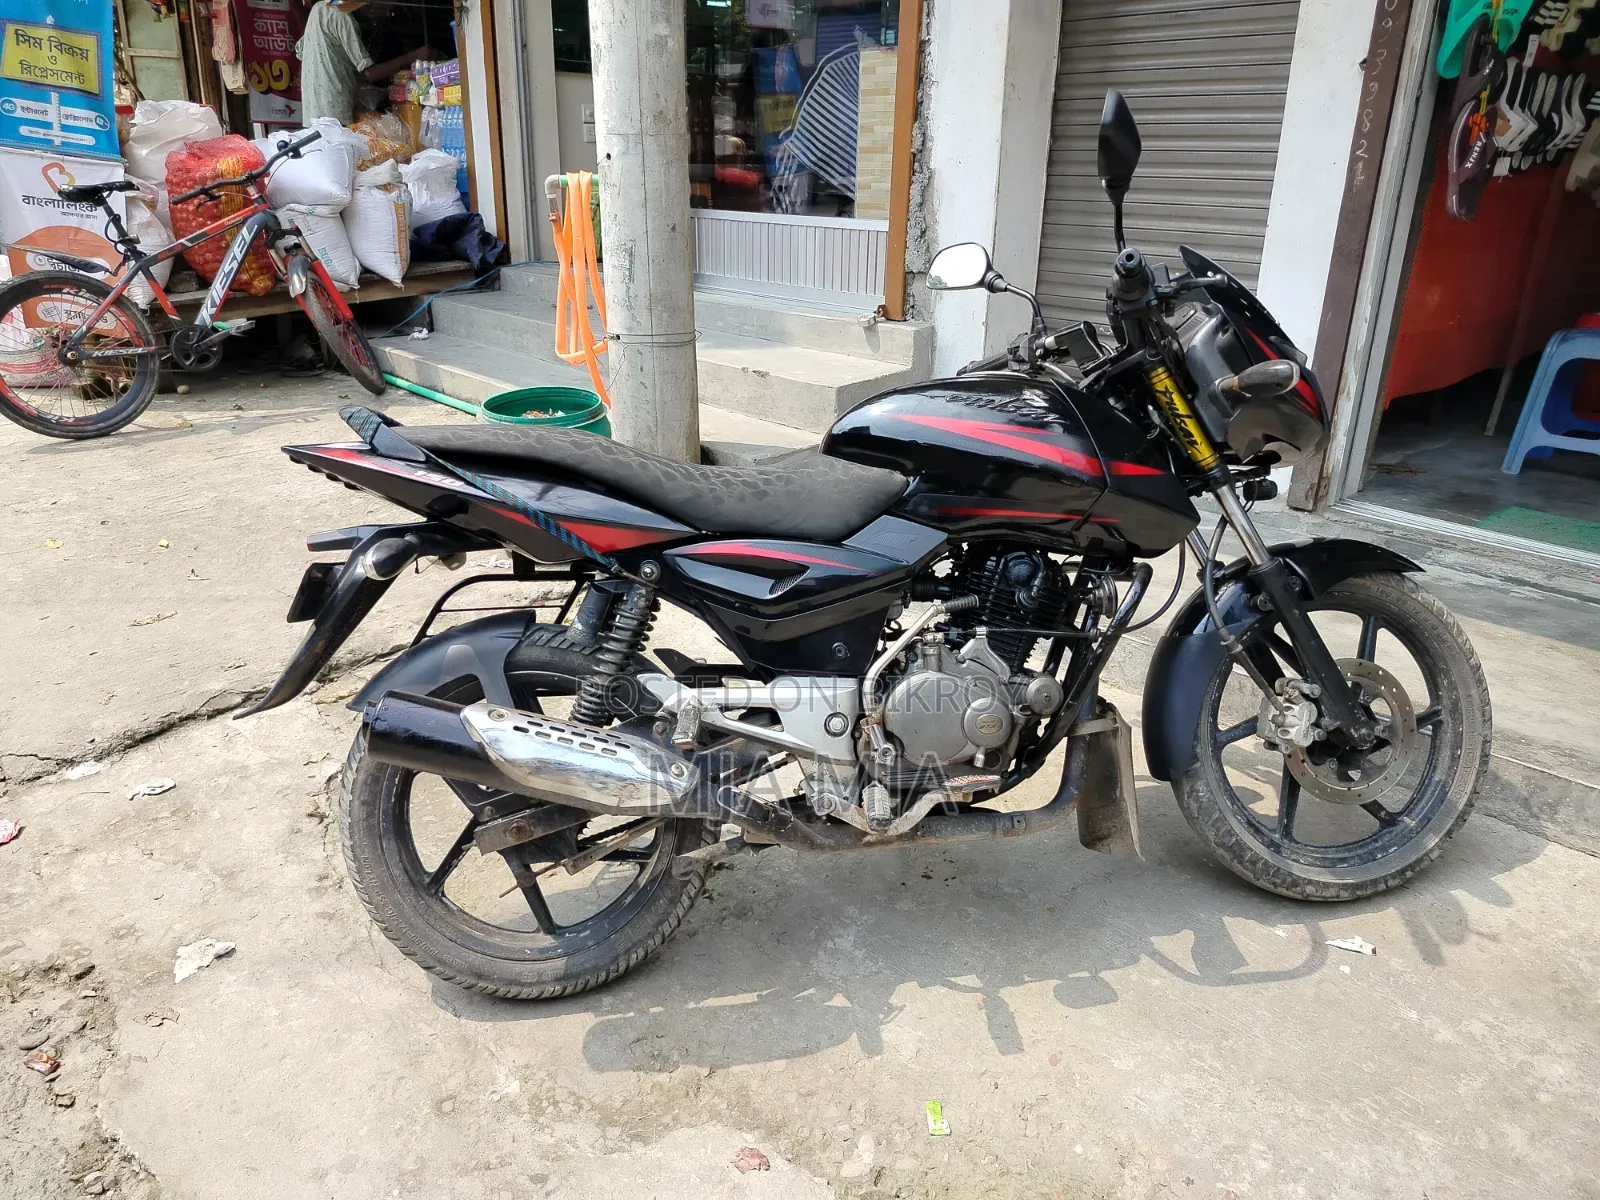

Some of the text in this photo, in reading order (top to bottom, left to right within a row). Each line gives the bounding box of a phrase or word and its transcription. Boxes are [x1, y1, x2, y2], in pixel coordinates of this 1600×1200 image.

[253, 18, 289, 35] ক্যাশ
[14, 28, 90, 62] সিম বিক্রয়
[253, 34, 295, 51] আউট
[47, 55, 57, 65] ও
[18, 59, 85, 85] রিপ্লেসমেন্ট
[2, 103, 16, 111] 4G
[21, 195, 98, 212] বাংলালিংক
[202, 224, 258, 328] KIESEL
[92, 347, 149, 357] KIESEL
